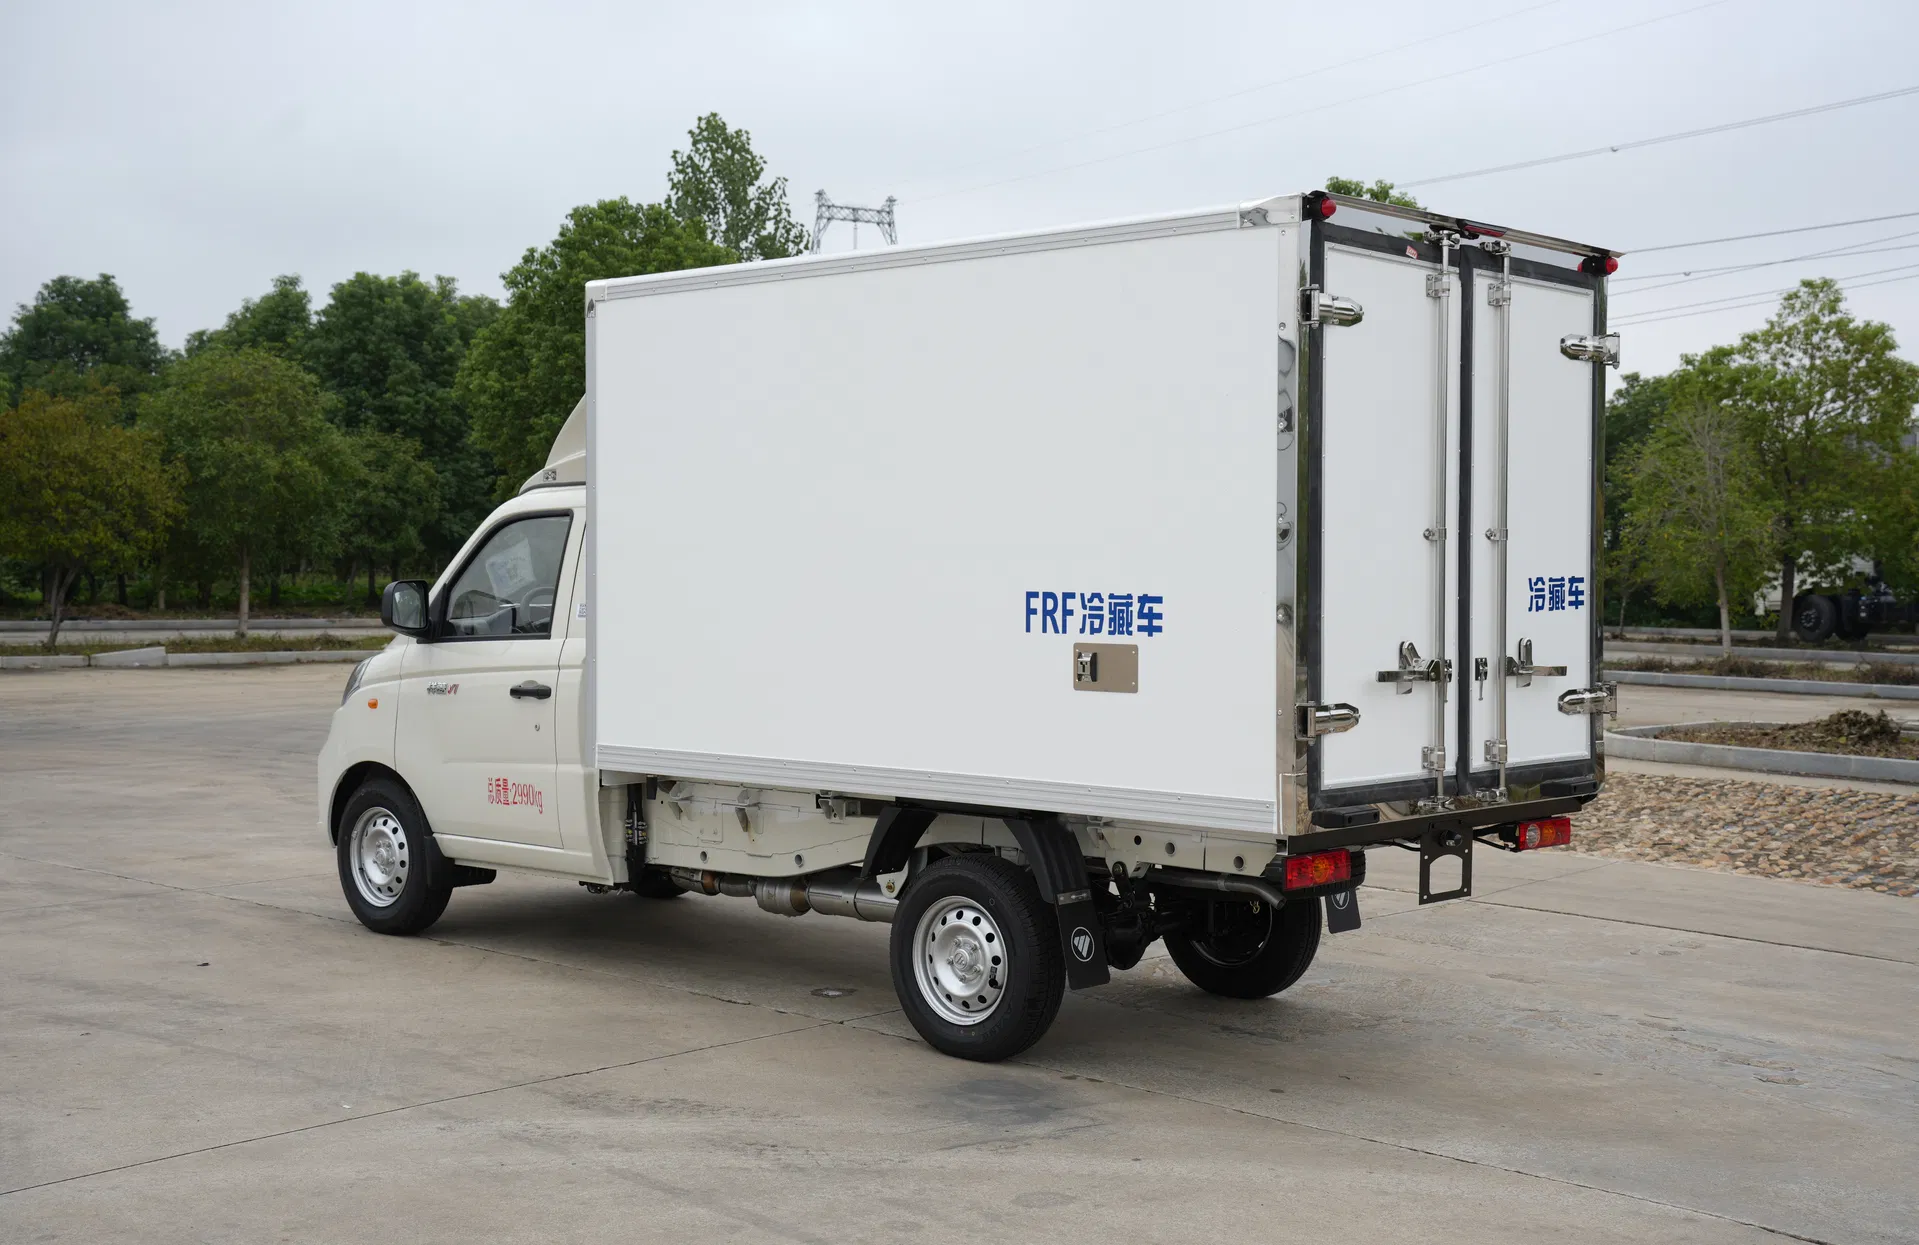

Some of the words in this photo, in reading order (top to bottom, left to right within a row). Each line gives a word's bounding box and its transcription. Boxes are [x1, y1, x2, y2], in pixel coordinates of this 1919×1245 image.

[1025, 591, 1164, 637] FRF冷藏车
[1528, 576, 1585, 612] 冷藏车
